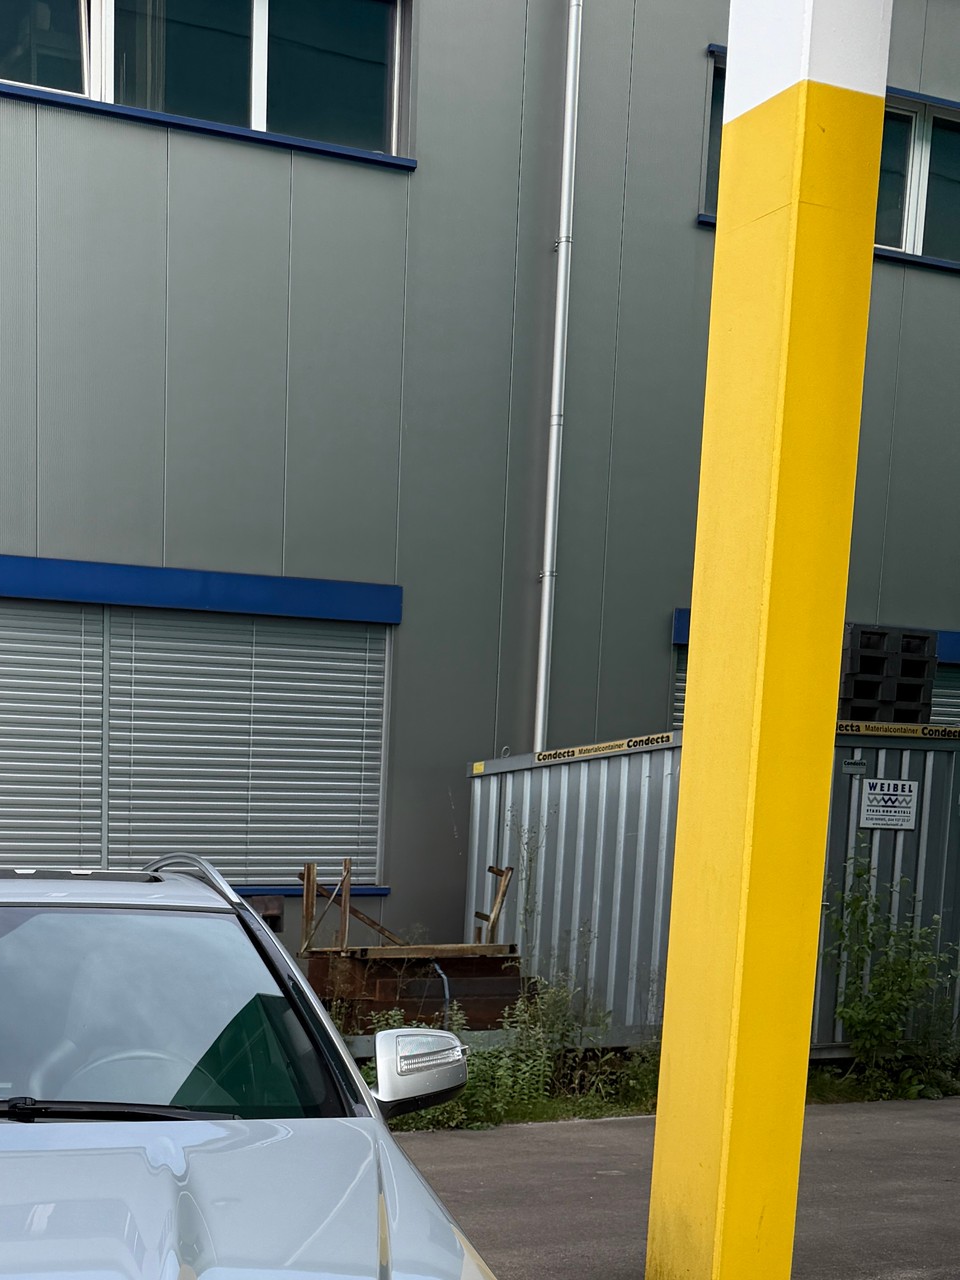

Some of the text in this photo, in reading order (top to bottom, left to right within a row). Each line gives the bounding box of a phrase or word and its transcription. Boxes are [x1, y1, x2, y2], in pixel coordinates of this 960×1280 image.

[865, 725, 918, 734] Materialcontainer
[537, 734, 670, 762] Condecta Materialcontainer Condecta
[868, 782, 913, 793] WEIBEL
